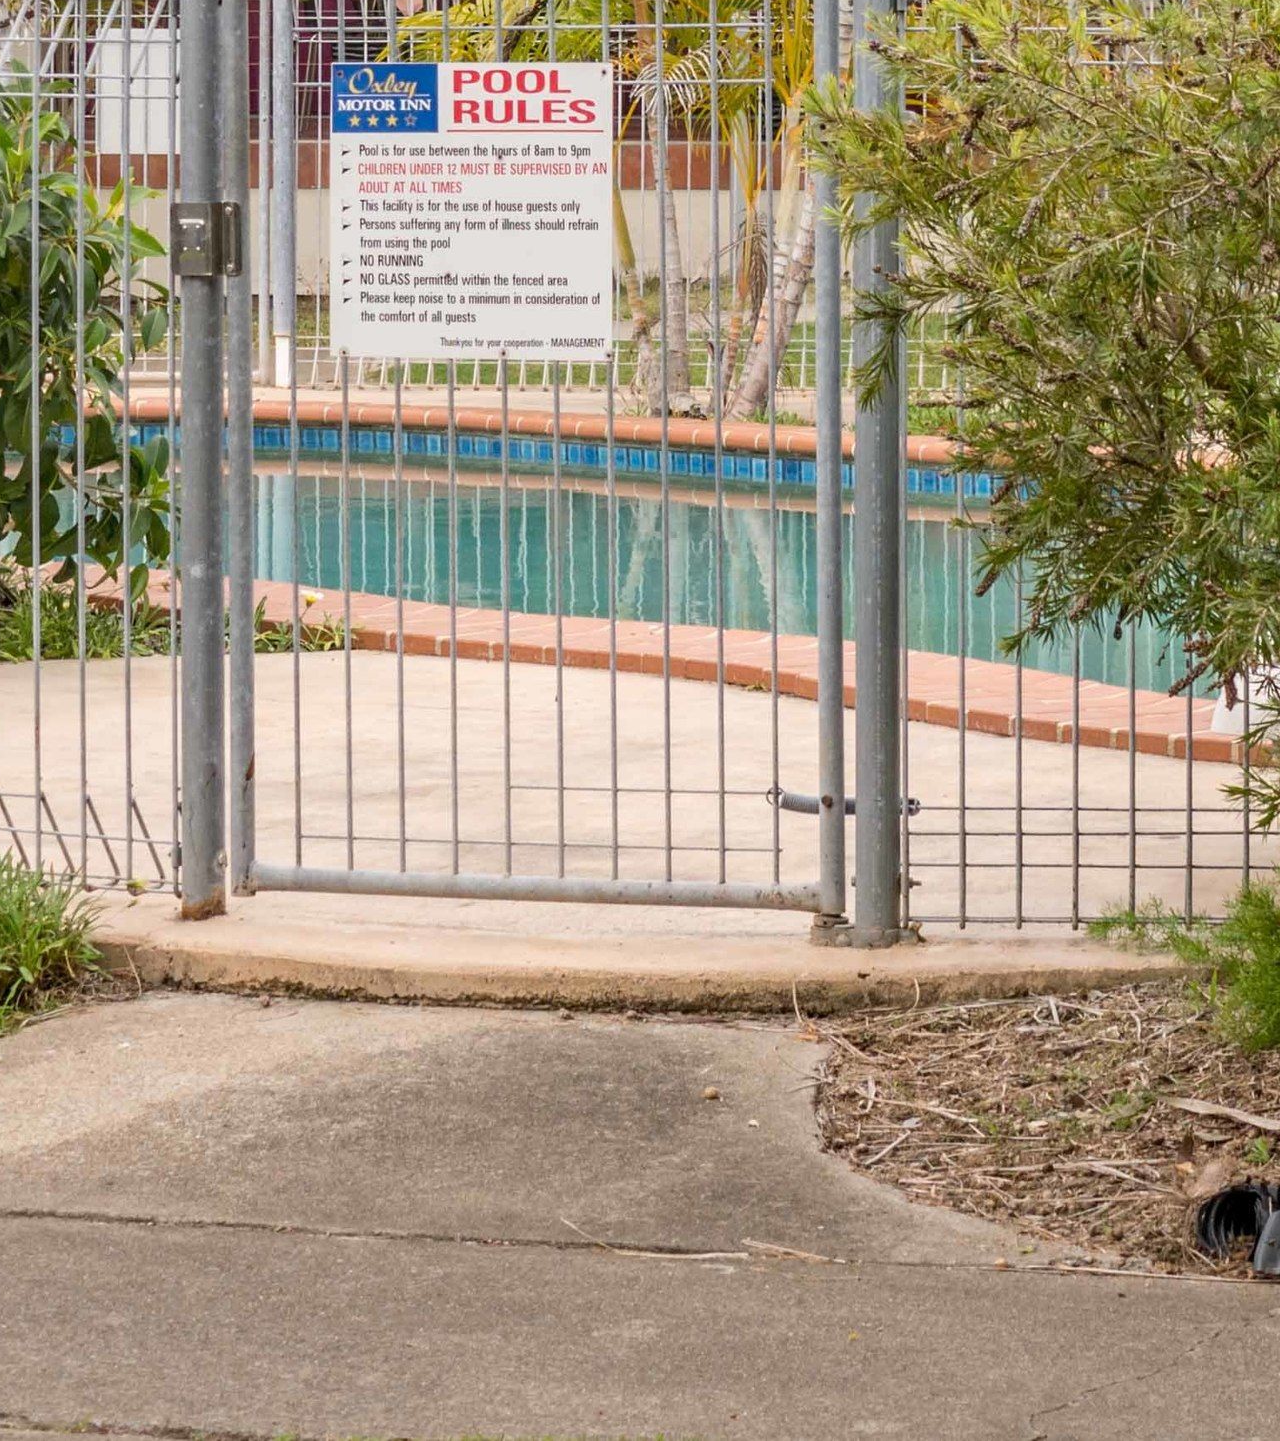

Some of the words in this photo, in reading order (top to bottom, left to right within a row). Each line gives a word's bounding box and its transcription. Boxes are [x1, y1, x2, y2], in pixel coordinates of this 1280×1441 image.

[349, 68, 417, 99] Oxley
[453, 69, 571, 94] POOL
[338, 99, 396, 111] MOTOR
[400, 99, 431, 111] INN
[453, 99, 596, 124] RULES
[358, 143, 379, 158] Pool
[381, 144, 390, 157] is
[392, 143, 406, 157] for
[408, 147, 426, 157] use
[428, 143, 471, 157] between
[473, 143, 489, 157] the
[492, 144, 518, 157] hours
[520, 143, 531, 157] of
[533, 144, 555, 157] 8am
[557, 145, 568, 157] to
[570, 144, 591, 160] 9pm
[357, 162, 407, 176] CHILDREN
[409, 162, 444, 175] UNDER
[447, 163, 457, 175] 12
[460, 162, 490, 176] MUST
[494, 163, 506, 175] BE
[510, 162, 572, 176] SUPERVISED
[575, 163, 588, 174] BY
[592, 162, 608, 175] AN
[358, 180, 390, 194] ADULT
[393, 180, 406, 194] AT
[409, 181, 428, 194] ALL
[430, 180, 463, 194] TIMES
[359, 198, 380, 212] This
[382, 199, 414, 215] facility
[415, 198, 425, 213] is
[427, 199, 441, 212] for
[443, 199, 460, 213] the
[462, 202, 480, 212] use
[481, 199, 492, 213] of
[494, 199, 524, 213] house
[525, 201, 558, 215] guests
[560, 199, 581, 216] only
[359, 217, 397, 231] Persons
[399, 217, 442, 234] suffering
[443, 220, 461, 234] any
[464, 218, 486, 231] form
[488, 217, 499, 231] of
[501, 217, 532, 231] illness
[534, 218, 566, 231] should
[567, 218, 599, 231] refrain
[359, 236, 382, 249] from
[384, 236, 410, 252] using
[412, 236, 428, 249] the
[430, 236, 451, 252] pool
[359, 253, 375, 267] NO
[377, 254, 424, 268] RUNNING
[359, 272, 375, 286] NO
[377, 272, 411, 286] GLASS
[414, 273, 458, 288] permitted
[461, 273, 491, 287] within
[493, 273, 510, 287] the
[512, 273, 545, 287] fenced
[547, 276, 569, 287] area
[359, 290, 391, 304] Please
[393, 291, 416, 307] keep
[418, 291, 444, 305] noise
[446, 293, 457, 305] to
[468, 291, 511, 305] minimum
[513, 291, 523, 305] in
[524, 292, 589, 305] consideration
[591, 291, 601, 305] of
[360, 309, 376, 323] the
[378, 309, 416, 323] comfort
[418, 309, 428, 323] of
[431, 310, 443, 323] all
[444, 311, 477, 326] guests
[474, 337, 485, 347] for
[486, 339, 502, 349] your
[504, 339, 543, 349] cooperation
[550, 337, 605, 348] MANAGEMENT
